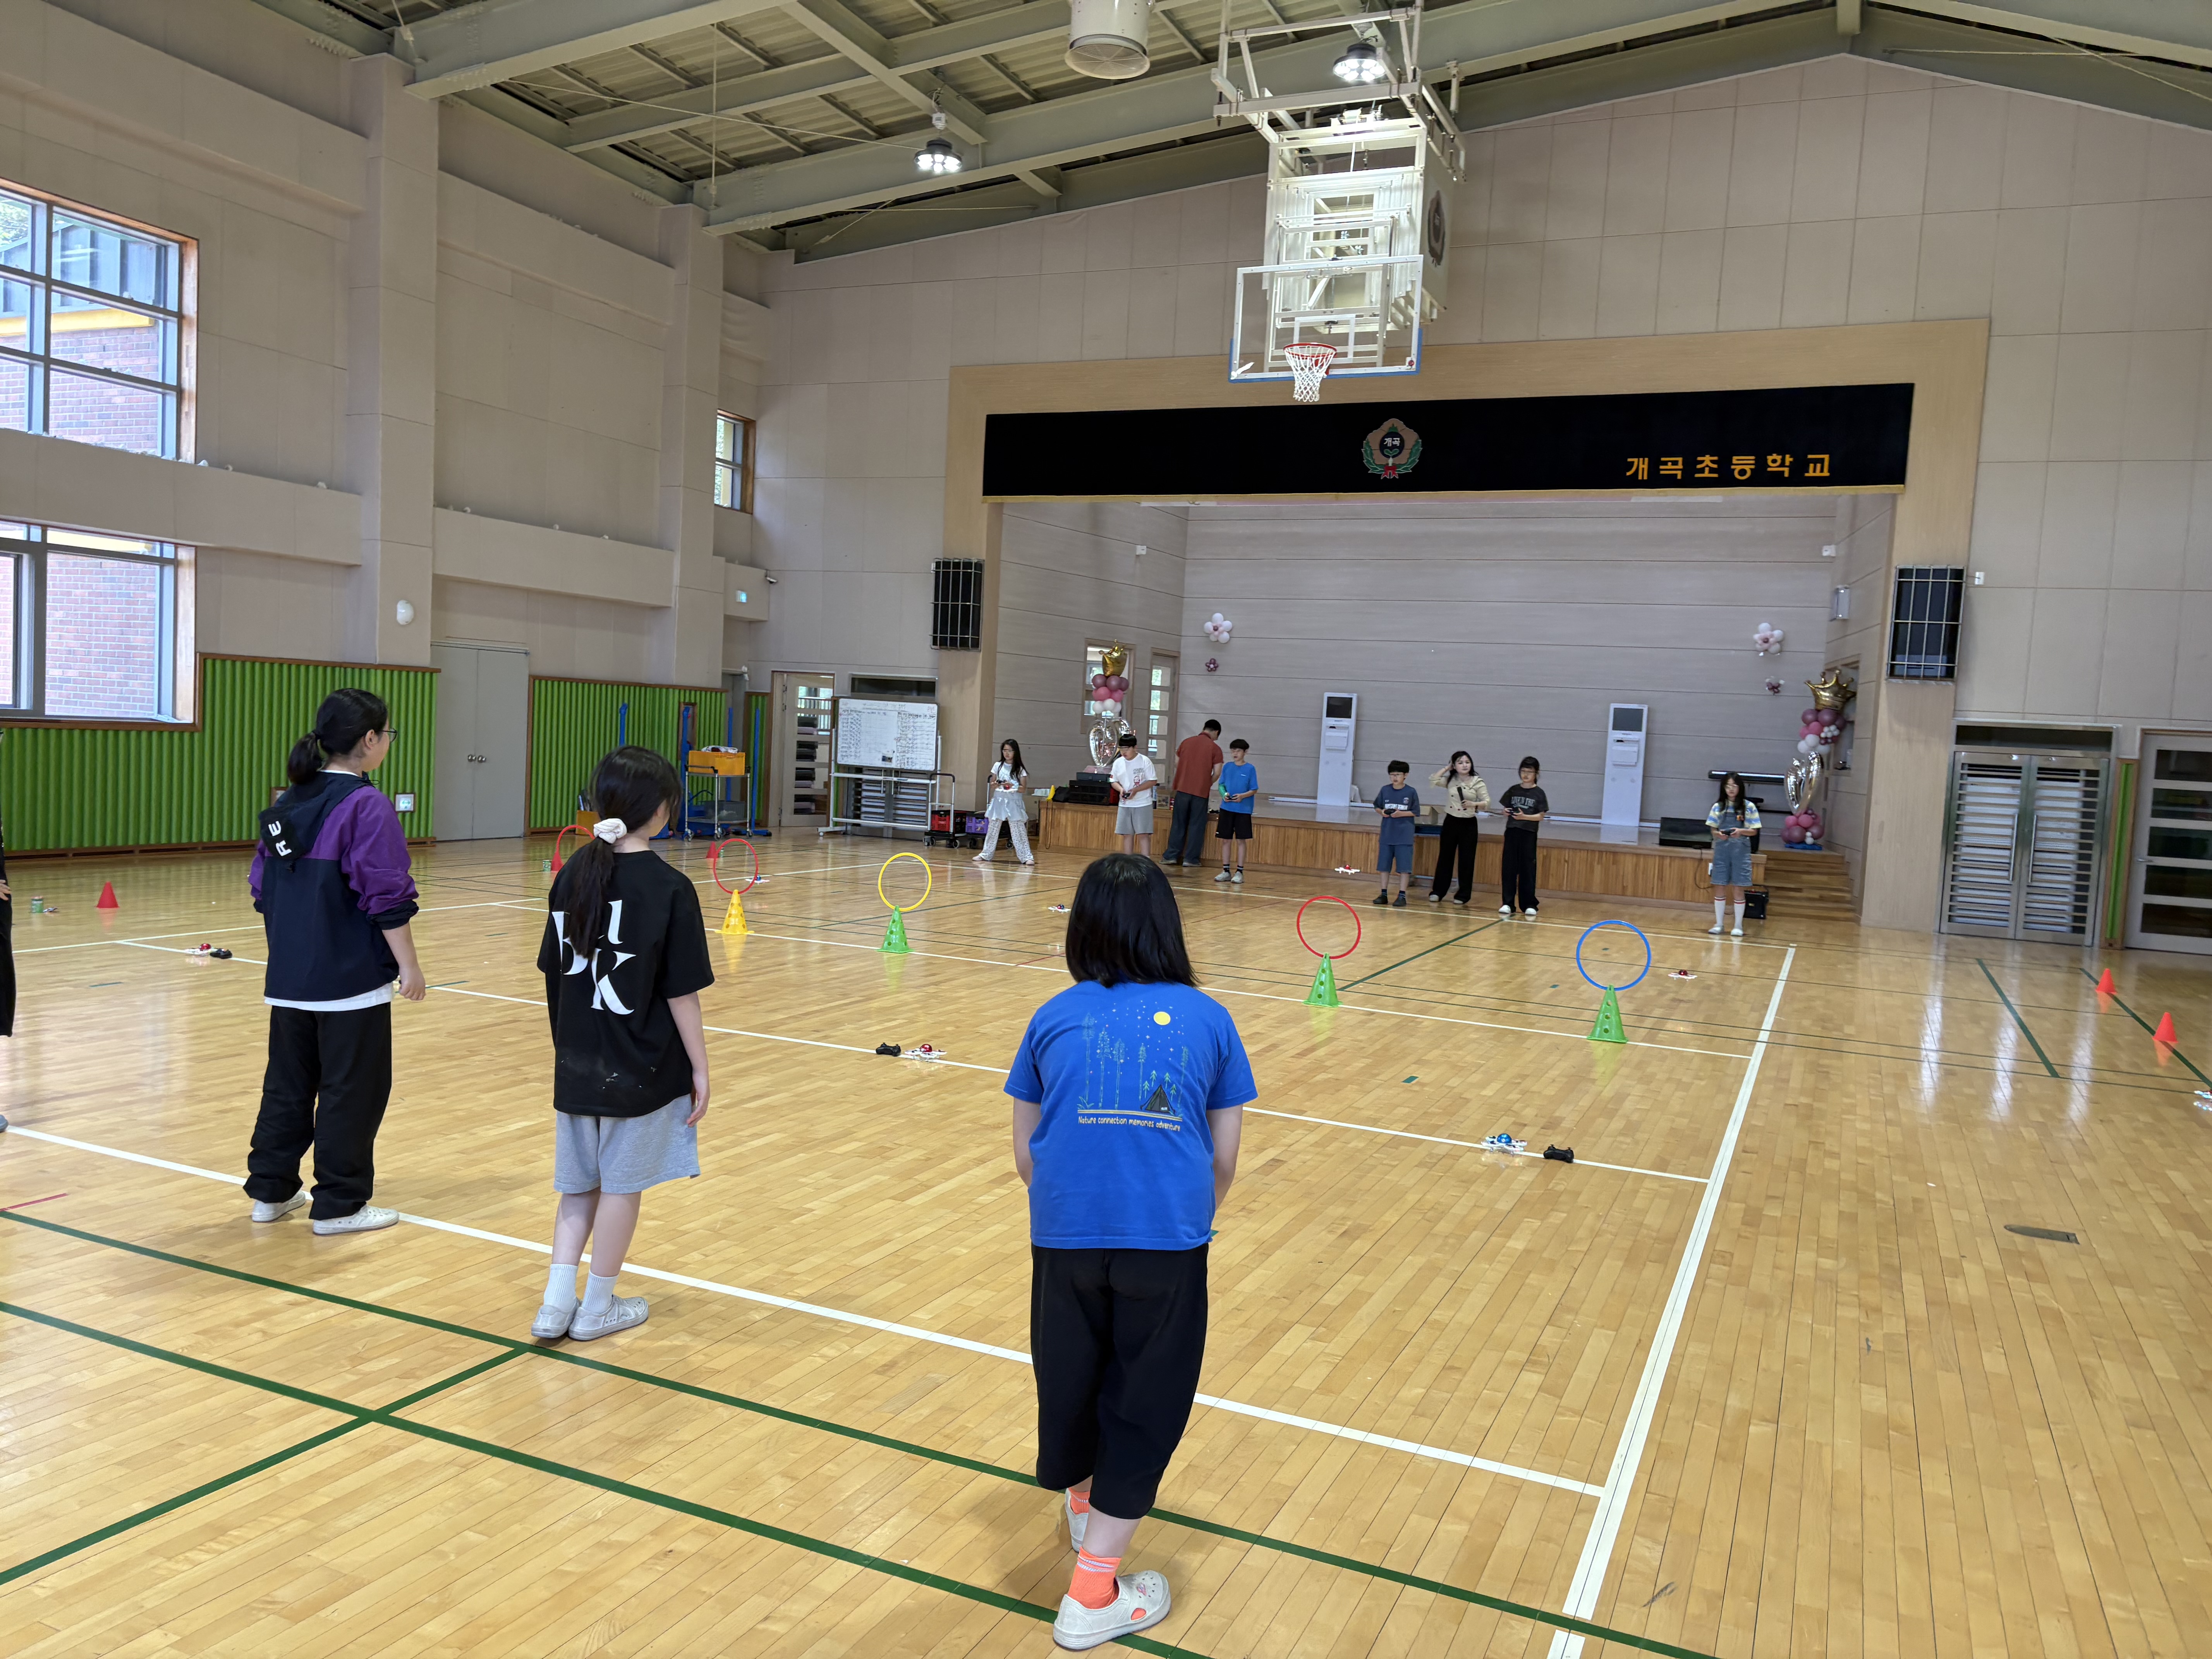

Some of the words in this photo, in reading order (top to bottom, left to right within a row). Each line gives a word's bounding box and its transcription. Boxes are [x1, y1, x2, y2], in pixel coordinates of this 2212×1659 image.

[1384, 438, 1400, 447] 개곡
[1626, 453, 1831, 480] 개곡초등학교
[1079, 1116, 1096, 1124] Nature
[1098, 1116, 1127, 1125] connection
[1129, 1119, 1154, 1128] memories
[1156, 1120, 1180, 1132] adventure
